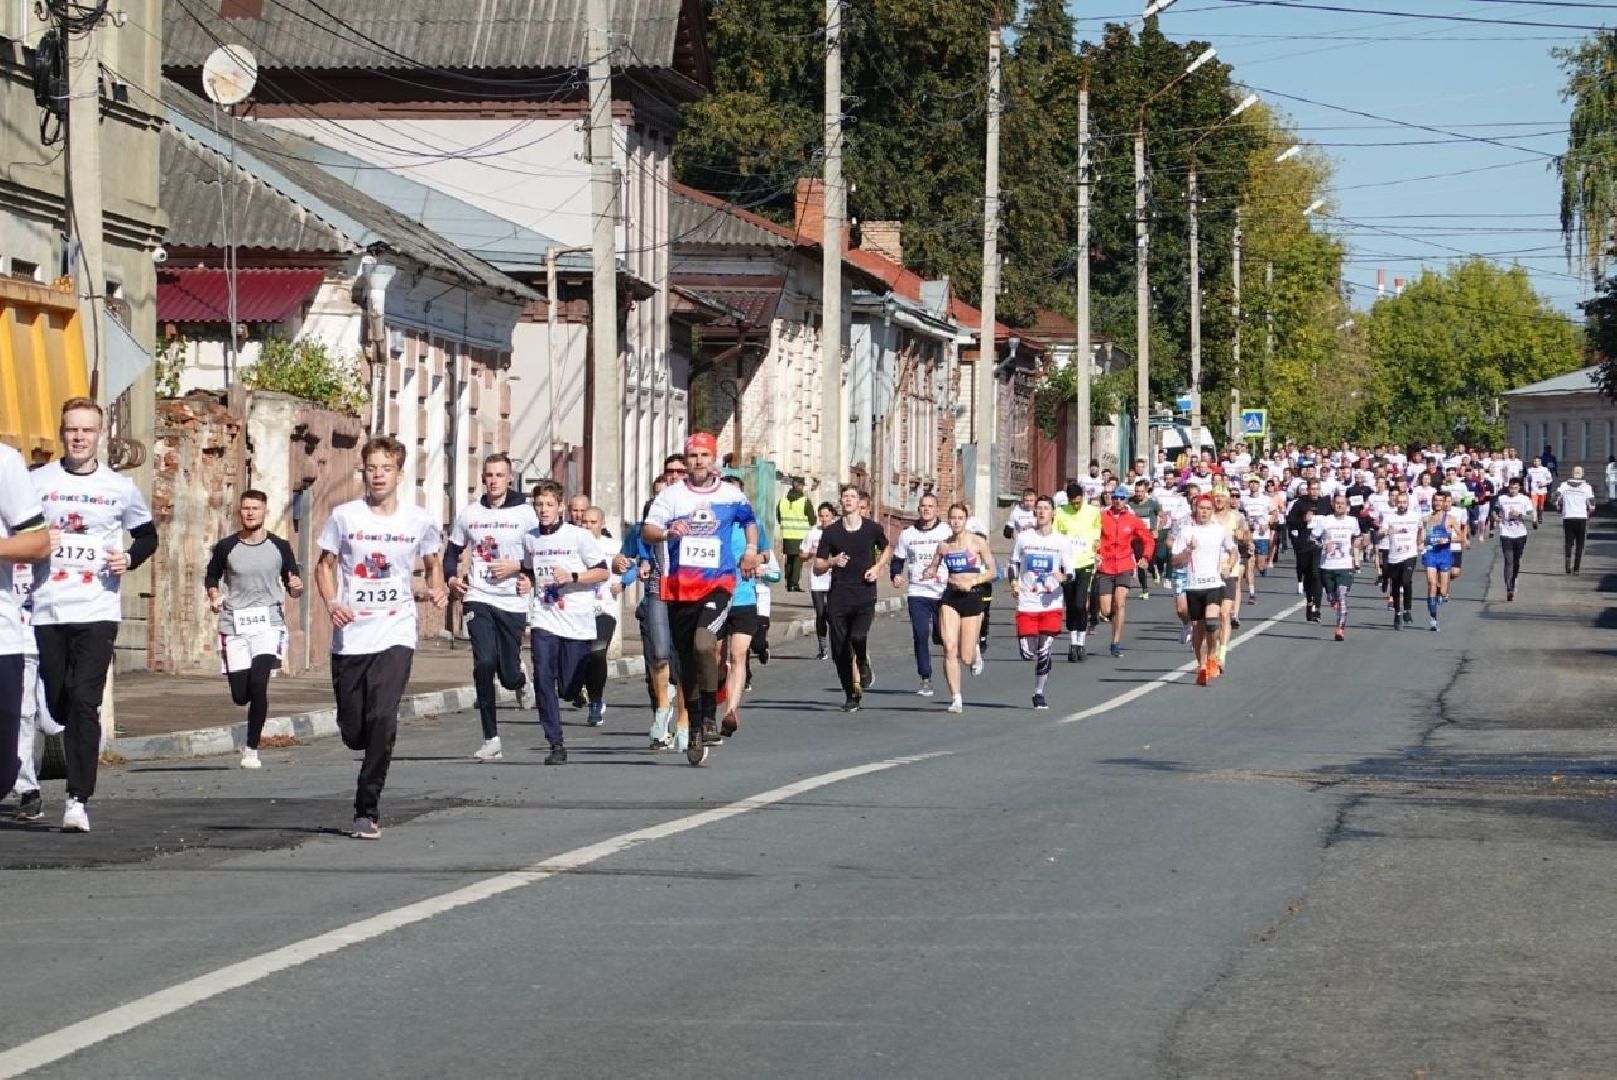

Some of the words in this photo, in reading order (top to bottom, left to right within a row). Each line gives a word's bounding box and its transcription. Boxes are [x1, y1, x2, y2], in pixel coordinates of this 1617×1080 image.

[55, 545, 96, 561] 2173
[686, 545, 716, 558] 1754
[355, 588, 398, 602] 2132
